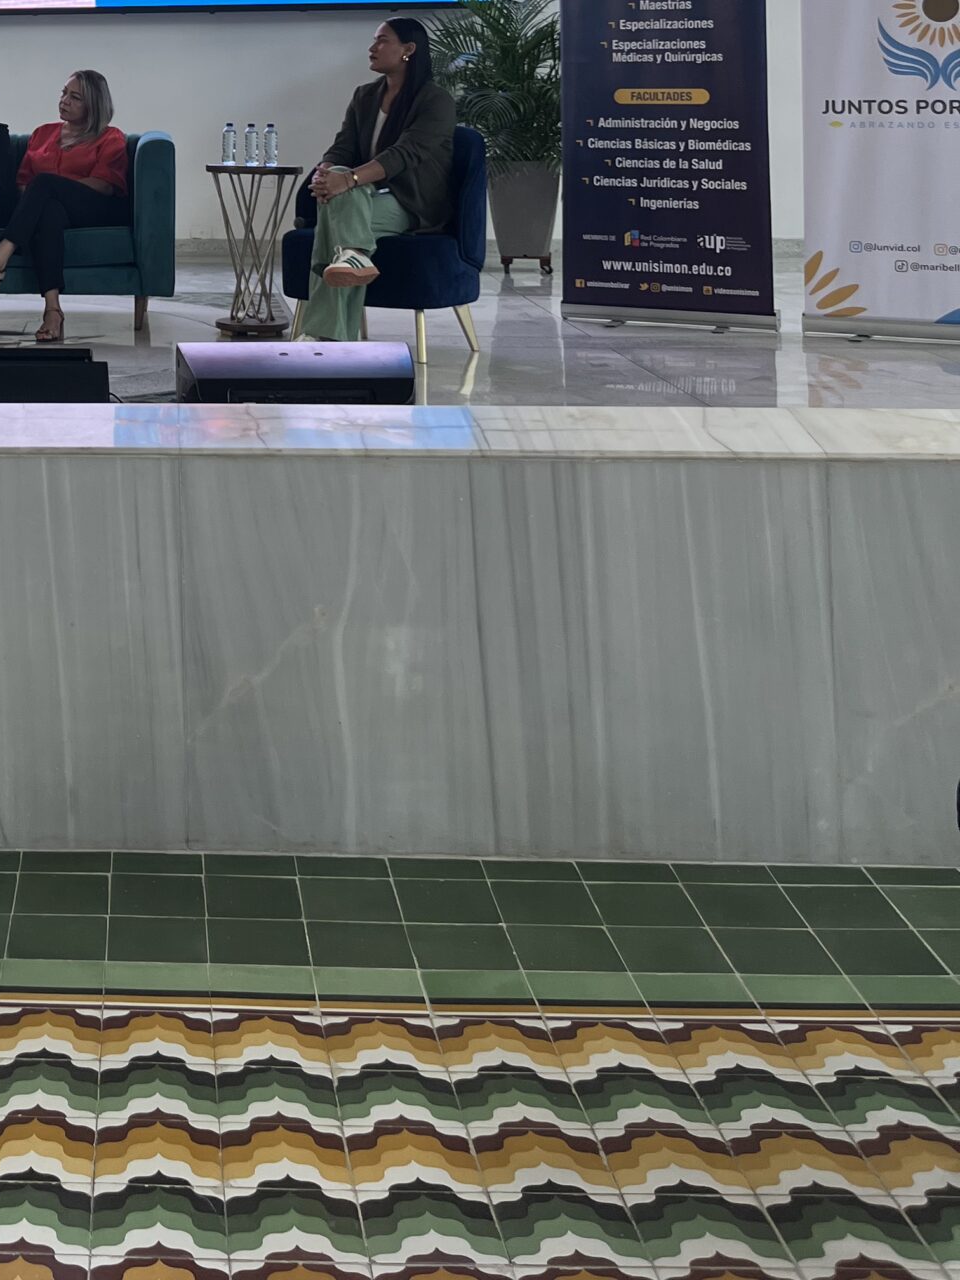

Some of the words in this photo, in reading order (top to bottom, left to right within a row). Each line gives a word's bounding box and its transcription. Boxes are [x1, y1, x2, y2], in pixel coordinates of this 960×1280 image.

[640, 0, 692, 10] Maestrías
[619, 19, 714, 31] Especializaciones
[612, 39, 706, 51] Especializaciones
[612, 52, 653, 62] Médicas
[656, 55, 661, 64] y
[664, 52, 723, 64] Quirúrgicas
[630, 91, 692, 102] FACULTADES
[822, 99, 908, 115] JUNTOS
[916, 99, 960, 115] POR
[598, 117, 678, 129] Administración
[681, 120, 686, 130] y
[690, 118, 739, 131] Negocios
[849, 121, 936, 129] ABRAZANDO
[944, 121, 960, 129] ES
[587, 138, 632, 149] Ciencias
[634, 138, 676, 150] Básicas
[679, 141, 685, 151] y
[688, 139, 751, 151] Biomédicas
[615, 157, 660, 169] Ciencias
[663, 158, 676, 169] de
[679, 158, 689, 169] la
[691, 159, 723, 170] Salud
[593, 176, 637, 188] Ciencias
[692, 180, 698, 190] y
[701, 178, 747, 190] Sociales
[602, 259, 732, 276] www.unisimon.edu.co
